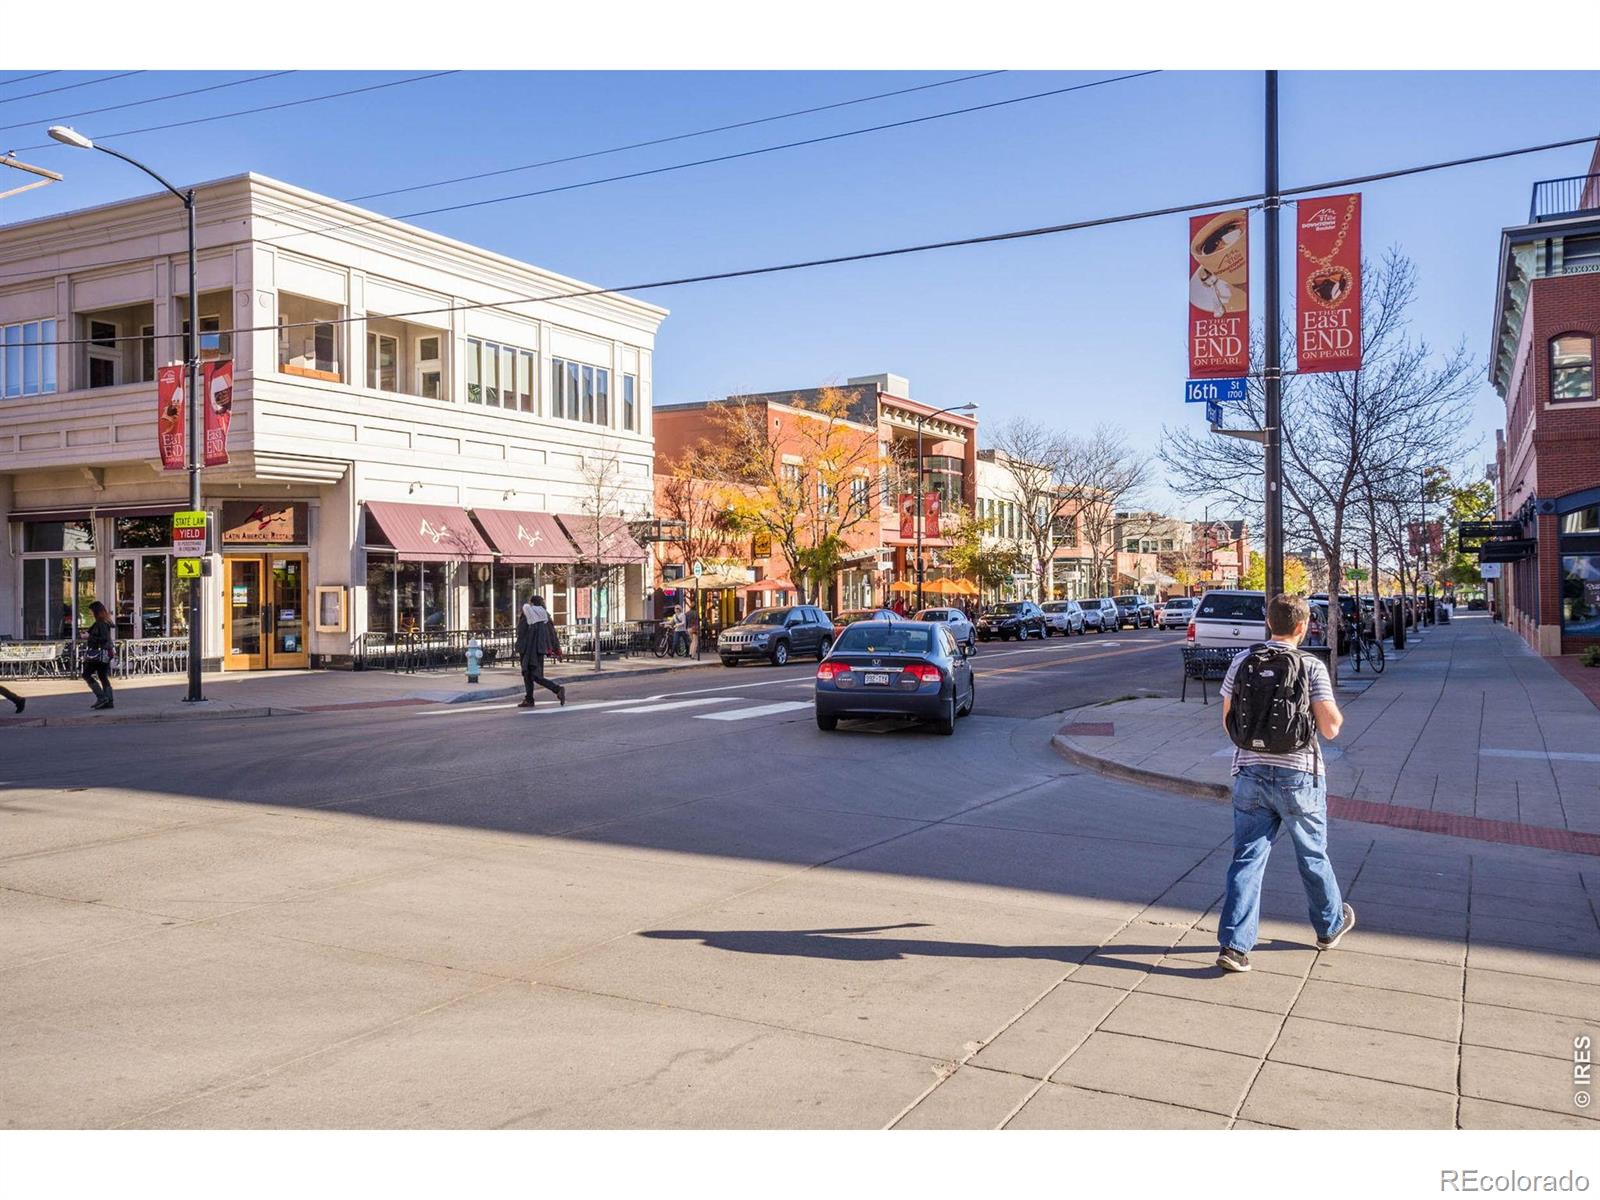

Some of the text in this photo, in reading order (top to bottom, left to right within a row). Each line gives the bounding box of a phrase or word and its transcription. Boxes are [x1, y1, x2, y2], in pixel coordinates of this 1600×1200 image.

[1303, 328, 1353, 351] END
[1194, 337, 1242, 359] END
[1303, 350, 1353, 360] ON PEARL
[1194, 357, 1241, 367] ON PEARL
[1188, 381, 1240, 400] 16th St
[1227, 390, 1243, 399] 1700
[175, 517, 204, 526] STATE LAW
[179, 529, 200, 538] YIELD
